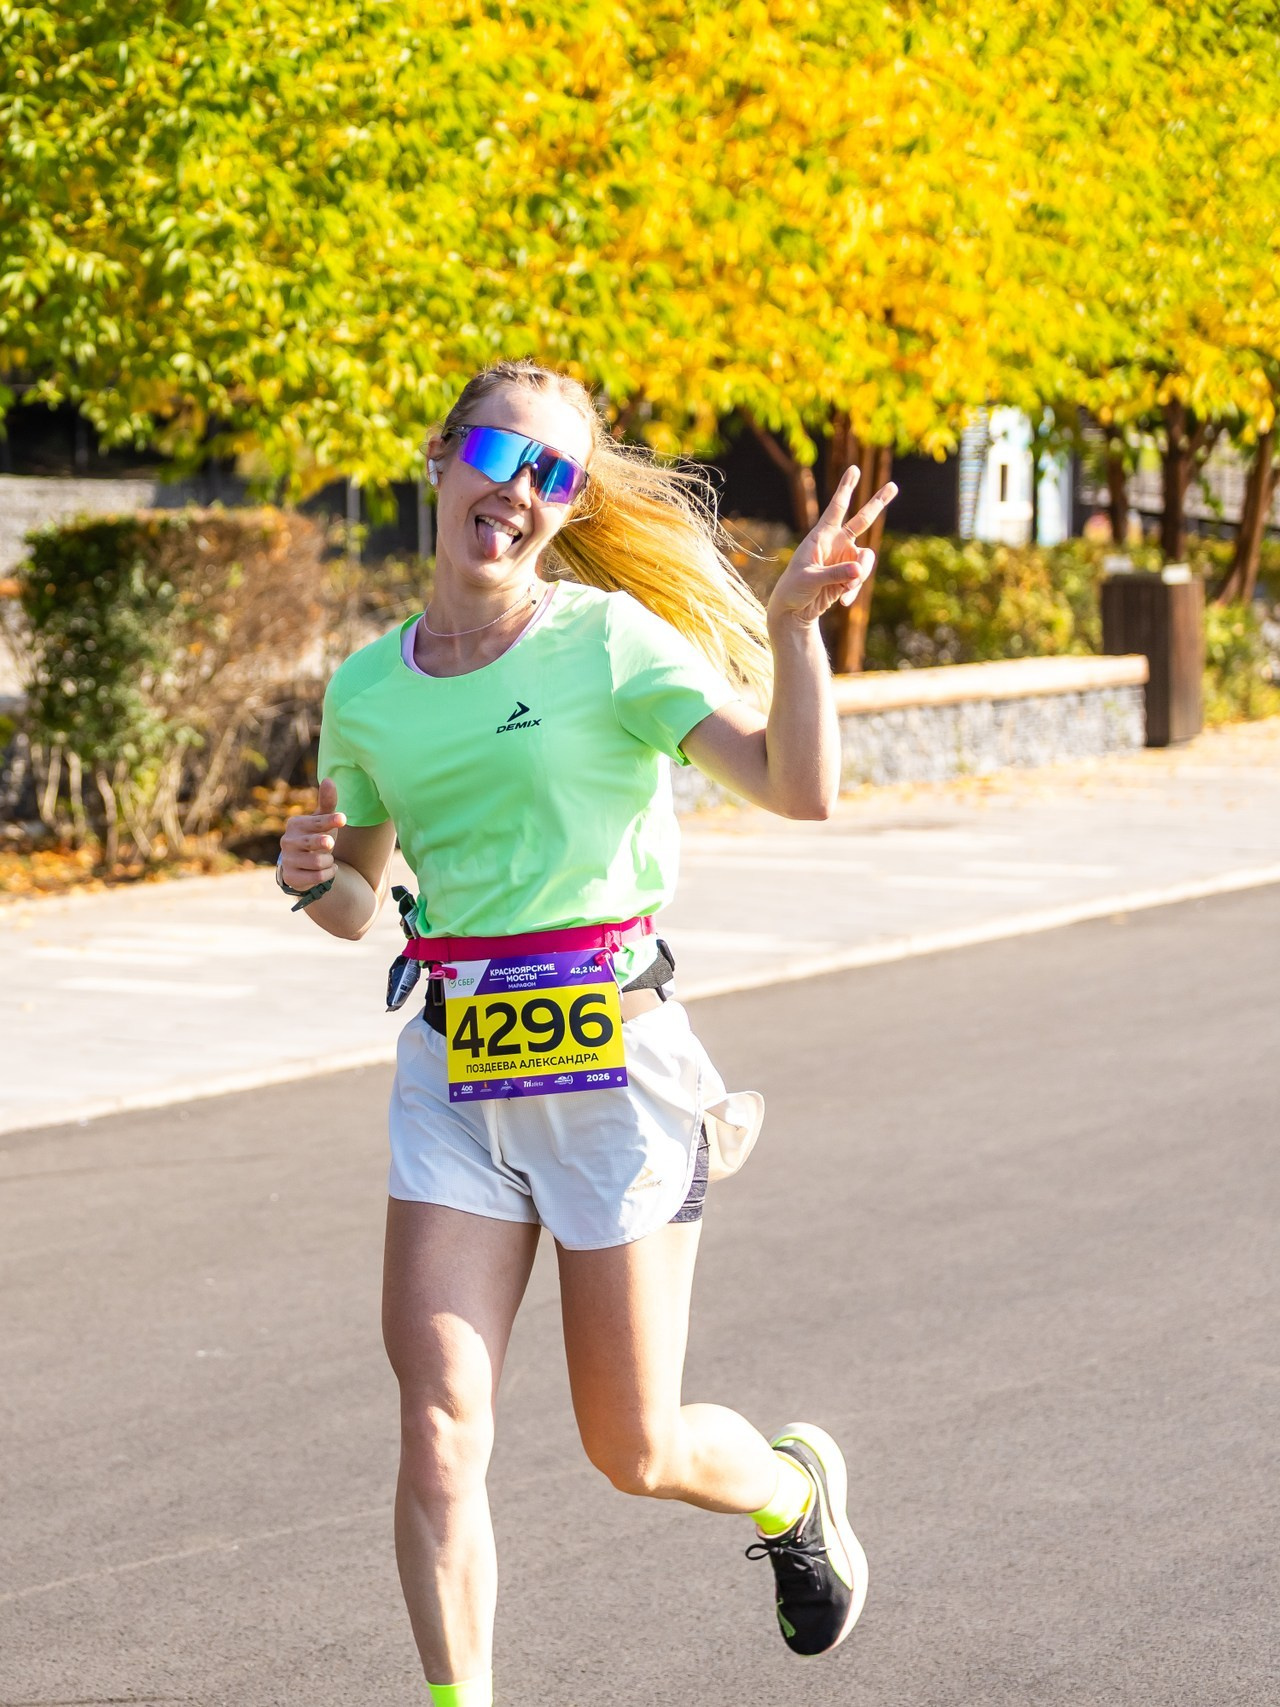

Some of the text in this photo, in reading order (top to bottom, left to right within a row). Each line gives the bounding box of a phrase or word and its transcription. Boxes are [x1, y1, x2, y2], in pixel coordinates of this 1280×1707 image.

[496, 718, 542, 734] DEMIX
[490, 963, 555, 976] КРАСНОЯРСКИЕ
[570, 965, 602, 975] 42,2 КМ
[458, 978, 474, 986] СБЕР
[506, 973, 537, 982] МОСТЫ
[508, 981, 536, 989] МАРАФОН
[452, 994, 613, 1058] 4296
[466, 1053, 599, 1074] ПОЗДЕЕВА АЛЕКСАНДРА
[587, 1073, 610, 1082] 2026
